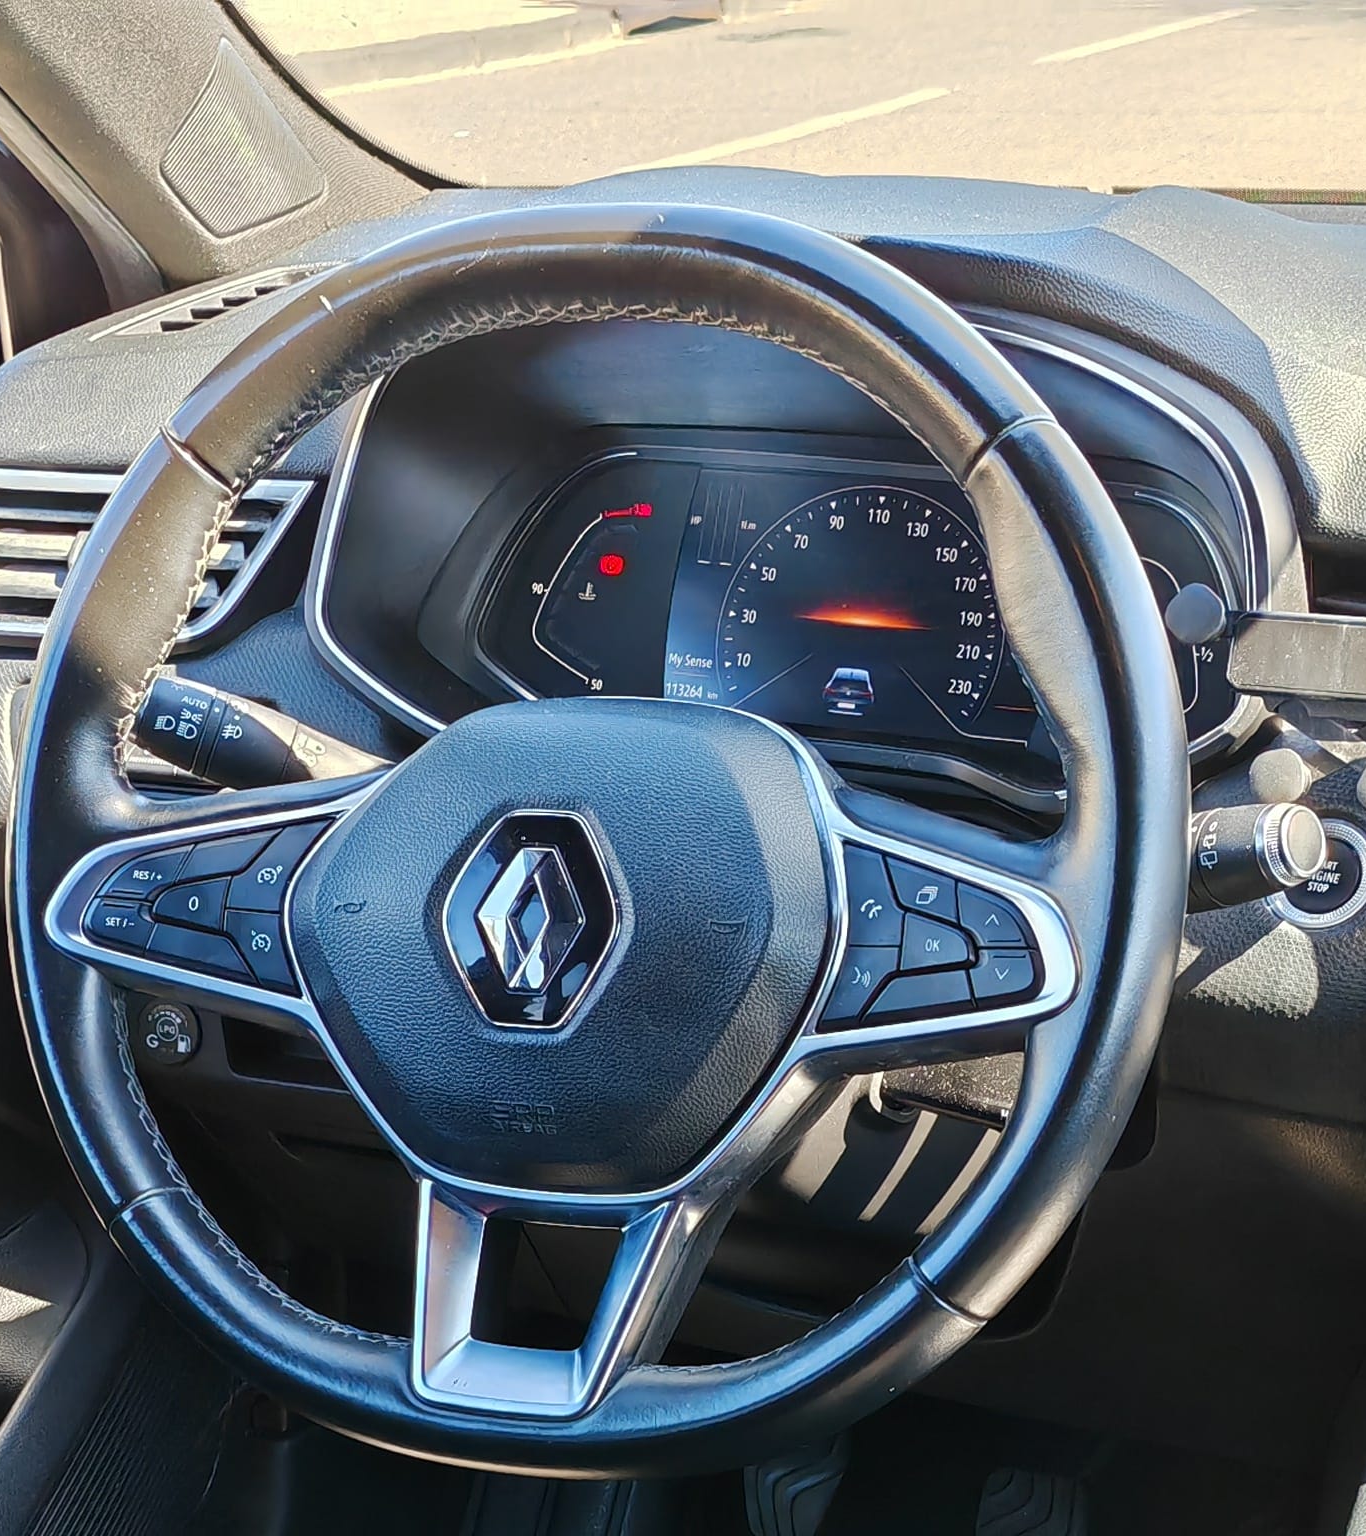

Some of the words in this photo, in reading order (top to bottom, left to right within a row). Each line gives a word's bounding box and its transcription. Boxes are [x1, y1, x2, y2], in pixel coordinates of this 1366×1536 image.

[829, 516, 844, 530] 90
[868, 508, 890, 525] 110
[906, 522, 929, 537] 130
[794, 535, 809, 549] 70
[935, 547, 958, 562] 150
[761, 567, 777, 582] 50
[531, 582, 544, 595] 90
[955, 577, 977, 592] 170
[741, 609, 757, 624] 30
[960, 611, 982, 627] 190
[736, 653, 751, 667] 10
[956, 645, 980, 660] 210
[668, 653, 683, 668] My
[684, 654, 713, 669] Sense
[591, 679, 603, 690] 50
[666, 682, 703, 699] 113264
[948, 679, 972, 695] 230
[181, 695, 208, 710] AUTO
[1307, 881, 1330, 893] STOP
[925, 938, 940, 952] OK
